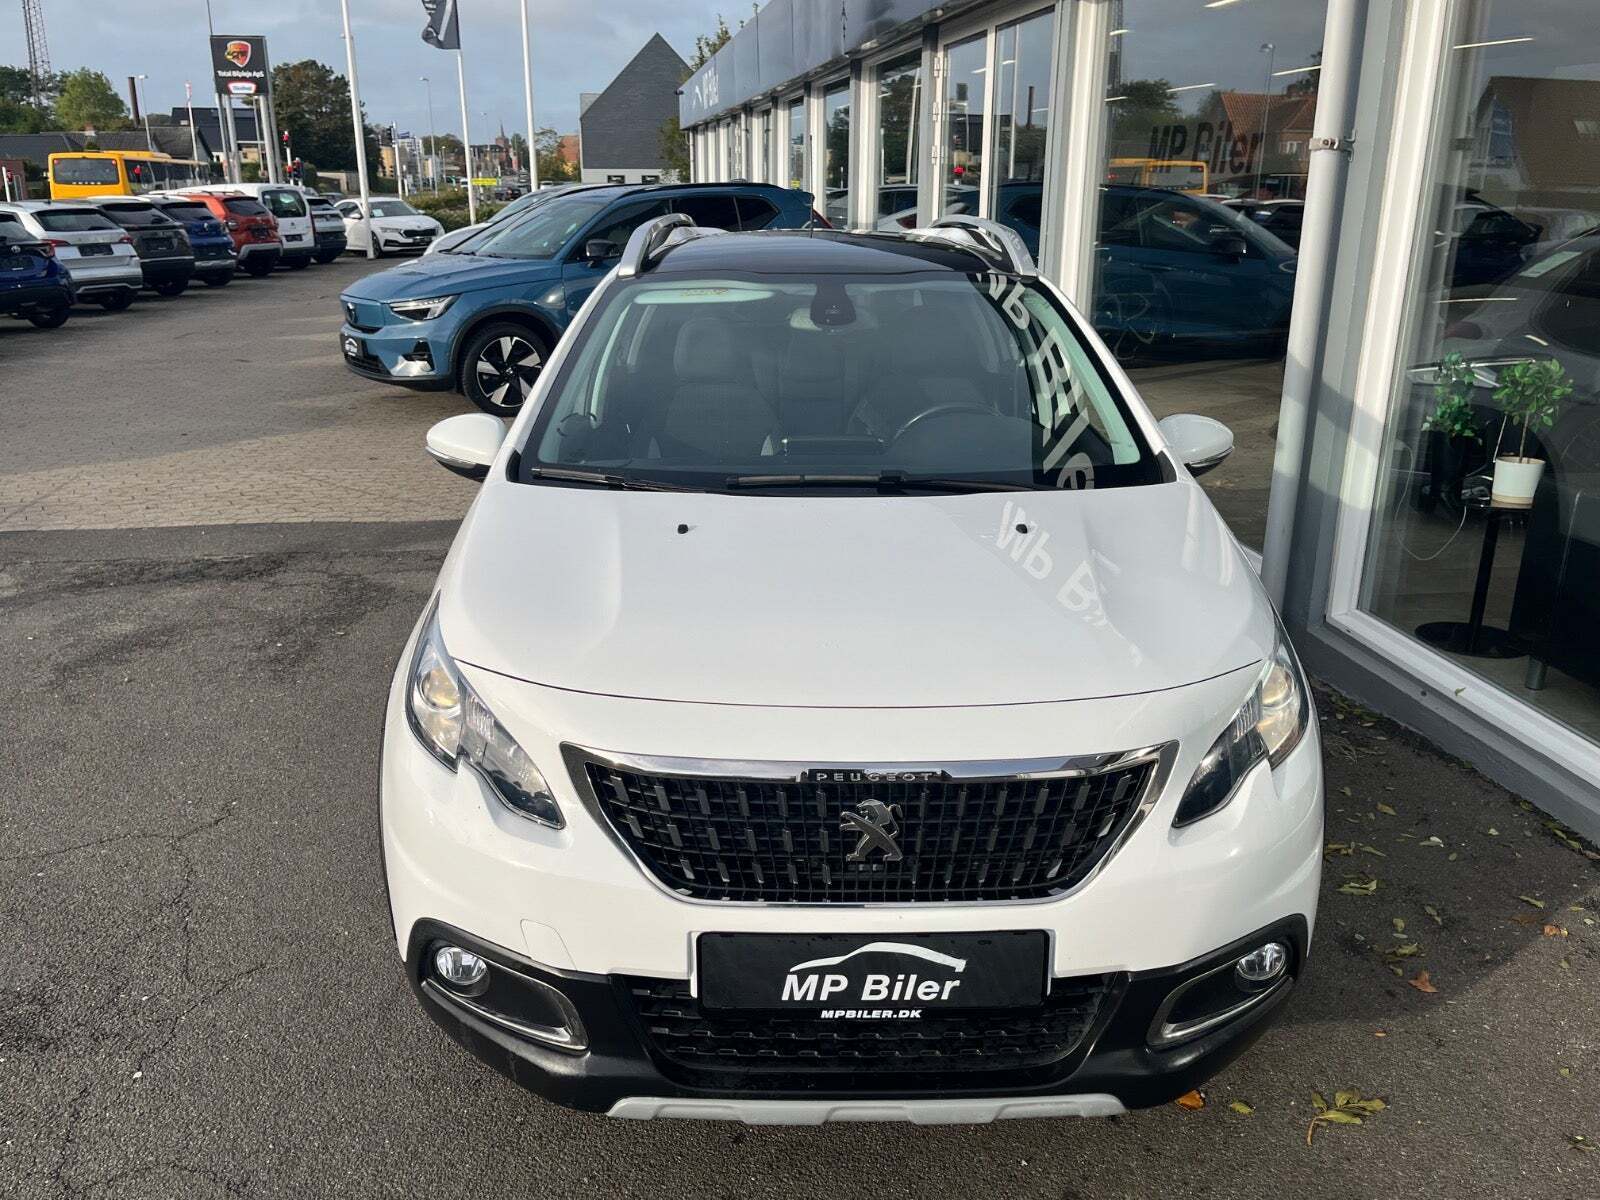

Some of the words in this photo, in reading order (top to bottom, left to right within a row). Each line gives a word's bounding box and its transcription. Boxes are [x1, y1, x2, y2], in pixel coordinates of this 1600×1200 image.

[816, 772, 933, 782] PEUGEOT
[782, 974, 848, 1001] MP
[861, 974, 960, 1001] Biler
[820, 1009, 922, 1019] MPBILER.DK
